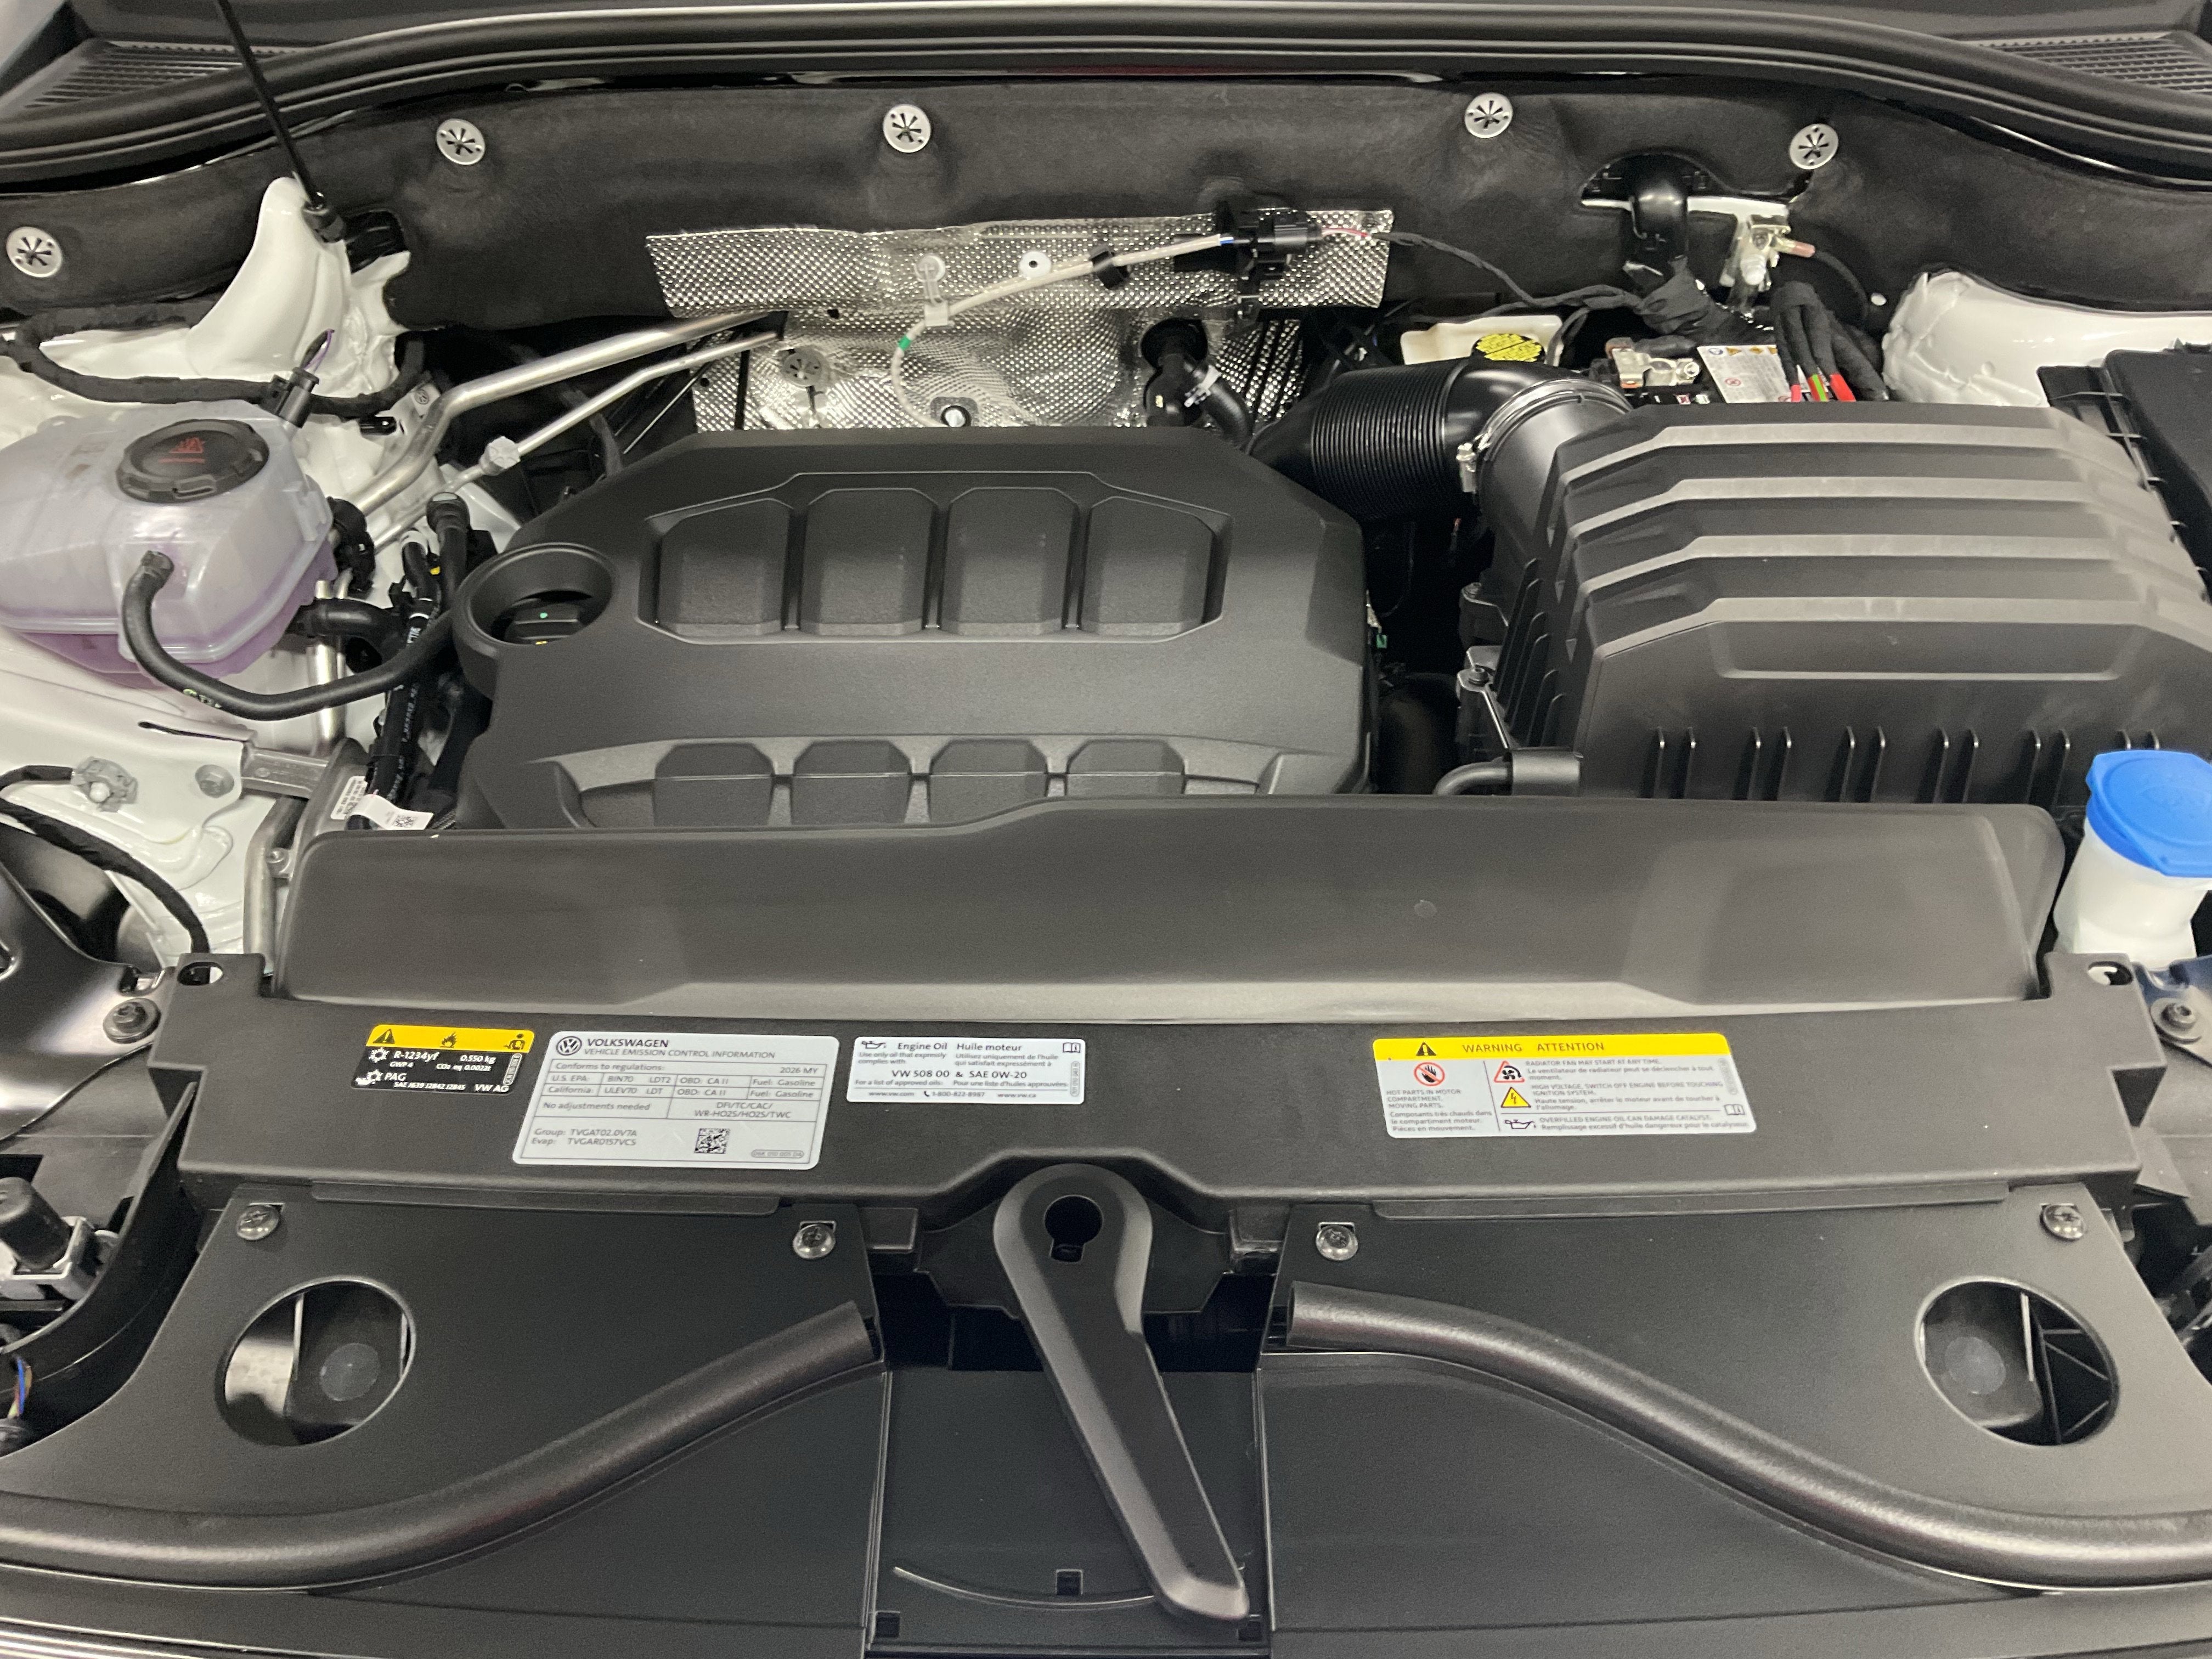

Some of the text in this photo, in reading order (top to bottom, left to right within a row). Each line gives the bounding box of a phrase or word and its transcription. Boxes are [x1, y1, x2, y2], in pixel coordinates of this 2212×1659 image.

[587, 1039, 669, 1047] VOLKSWAGEN
[898, 1042, 931, 1051] Engine
[1462, 1042, 1604, 1053] WARNING ATTENTION
[393, 1051, 440, 1062] R-1234yf
[460, 1054, 496, 1064] 0.550 kg
[385, 1073, 407, 1081] PAG
[475, 1084, 493, 1092] VW
[558, 1103, 614, 1111] adjustments
